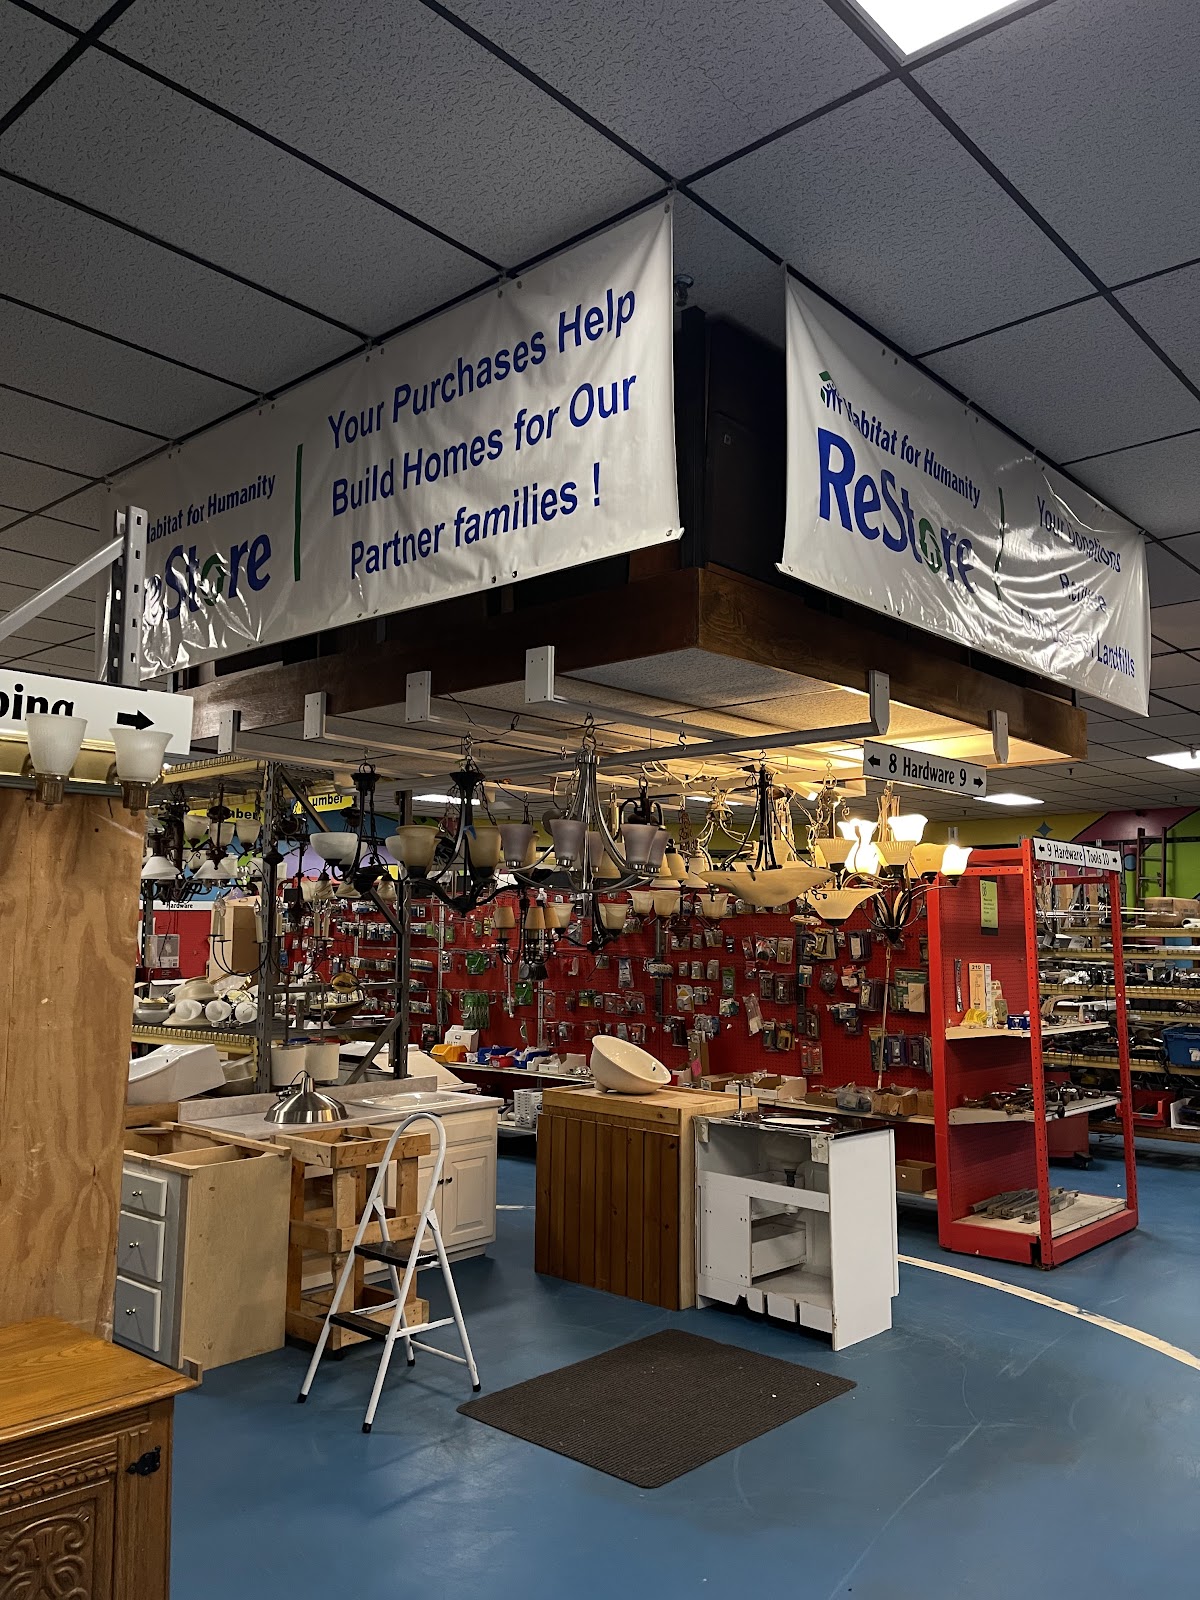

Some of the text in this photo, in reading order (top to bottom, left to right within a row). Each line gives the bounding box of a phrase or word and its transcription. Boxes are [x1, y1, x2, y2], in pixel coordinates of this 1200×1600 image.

[328, 288, 635, 449] Your Purchases Help
[333, 375, 636, 517] Build Homes for Our
[842, 397, 980, 509] Habitat for Humanity
[187, 504, 204, 526] for
[208, 475, 275, 517] Humanity
[351, 519, 446, 580] Partner
[454, 481, 578, 547] families
[818, 427, 976, 594] ReStore
[1037, 495, 1121, 573] Your Donations
[1096, 633, 1135, 677] Landfills
[312, 793, 344, 807] umber
[888, 753, 967, 787] 8 Hardware 9
[1046, 843, 1083, 862] 9 Hardware
[1086, 849, 1110, 866] Tools 10
